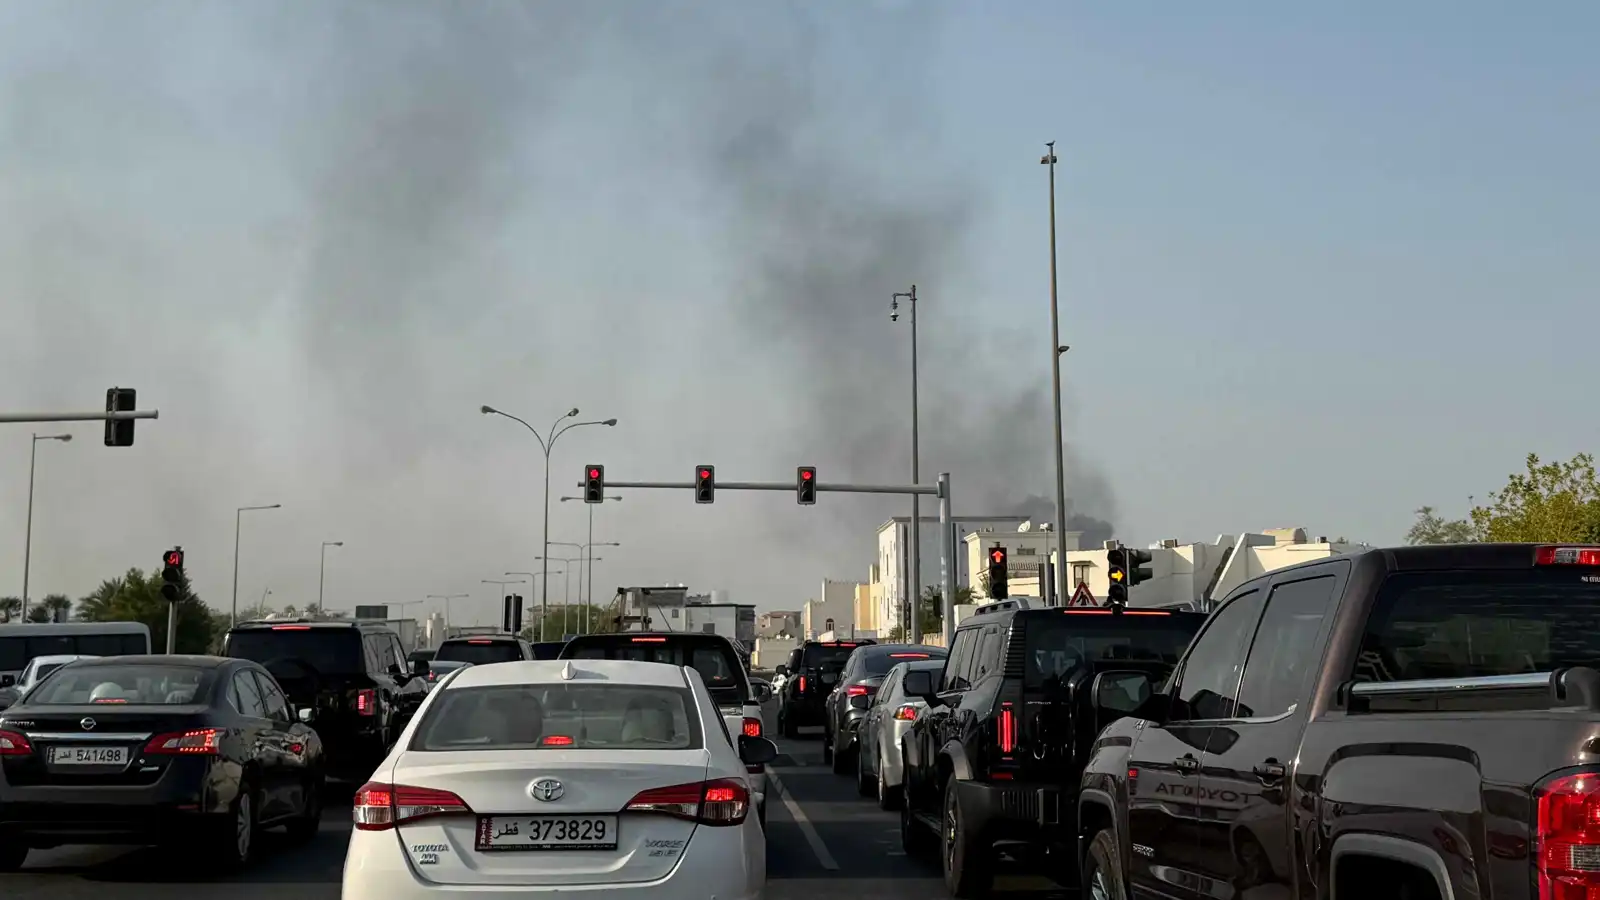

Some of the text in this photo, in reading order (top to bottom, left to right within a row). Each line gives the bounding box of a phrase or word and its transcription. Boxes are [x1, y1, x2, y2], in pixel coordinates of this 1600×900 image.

[76, 749, 121, 762] 541498
[479, 817, 488, 845] QATAR
[492, 820, 606, 841] قطر 373829
[411, 843, 449, 852] TOYOTA
